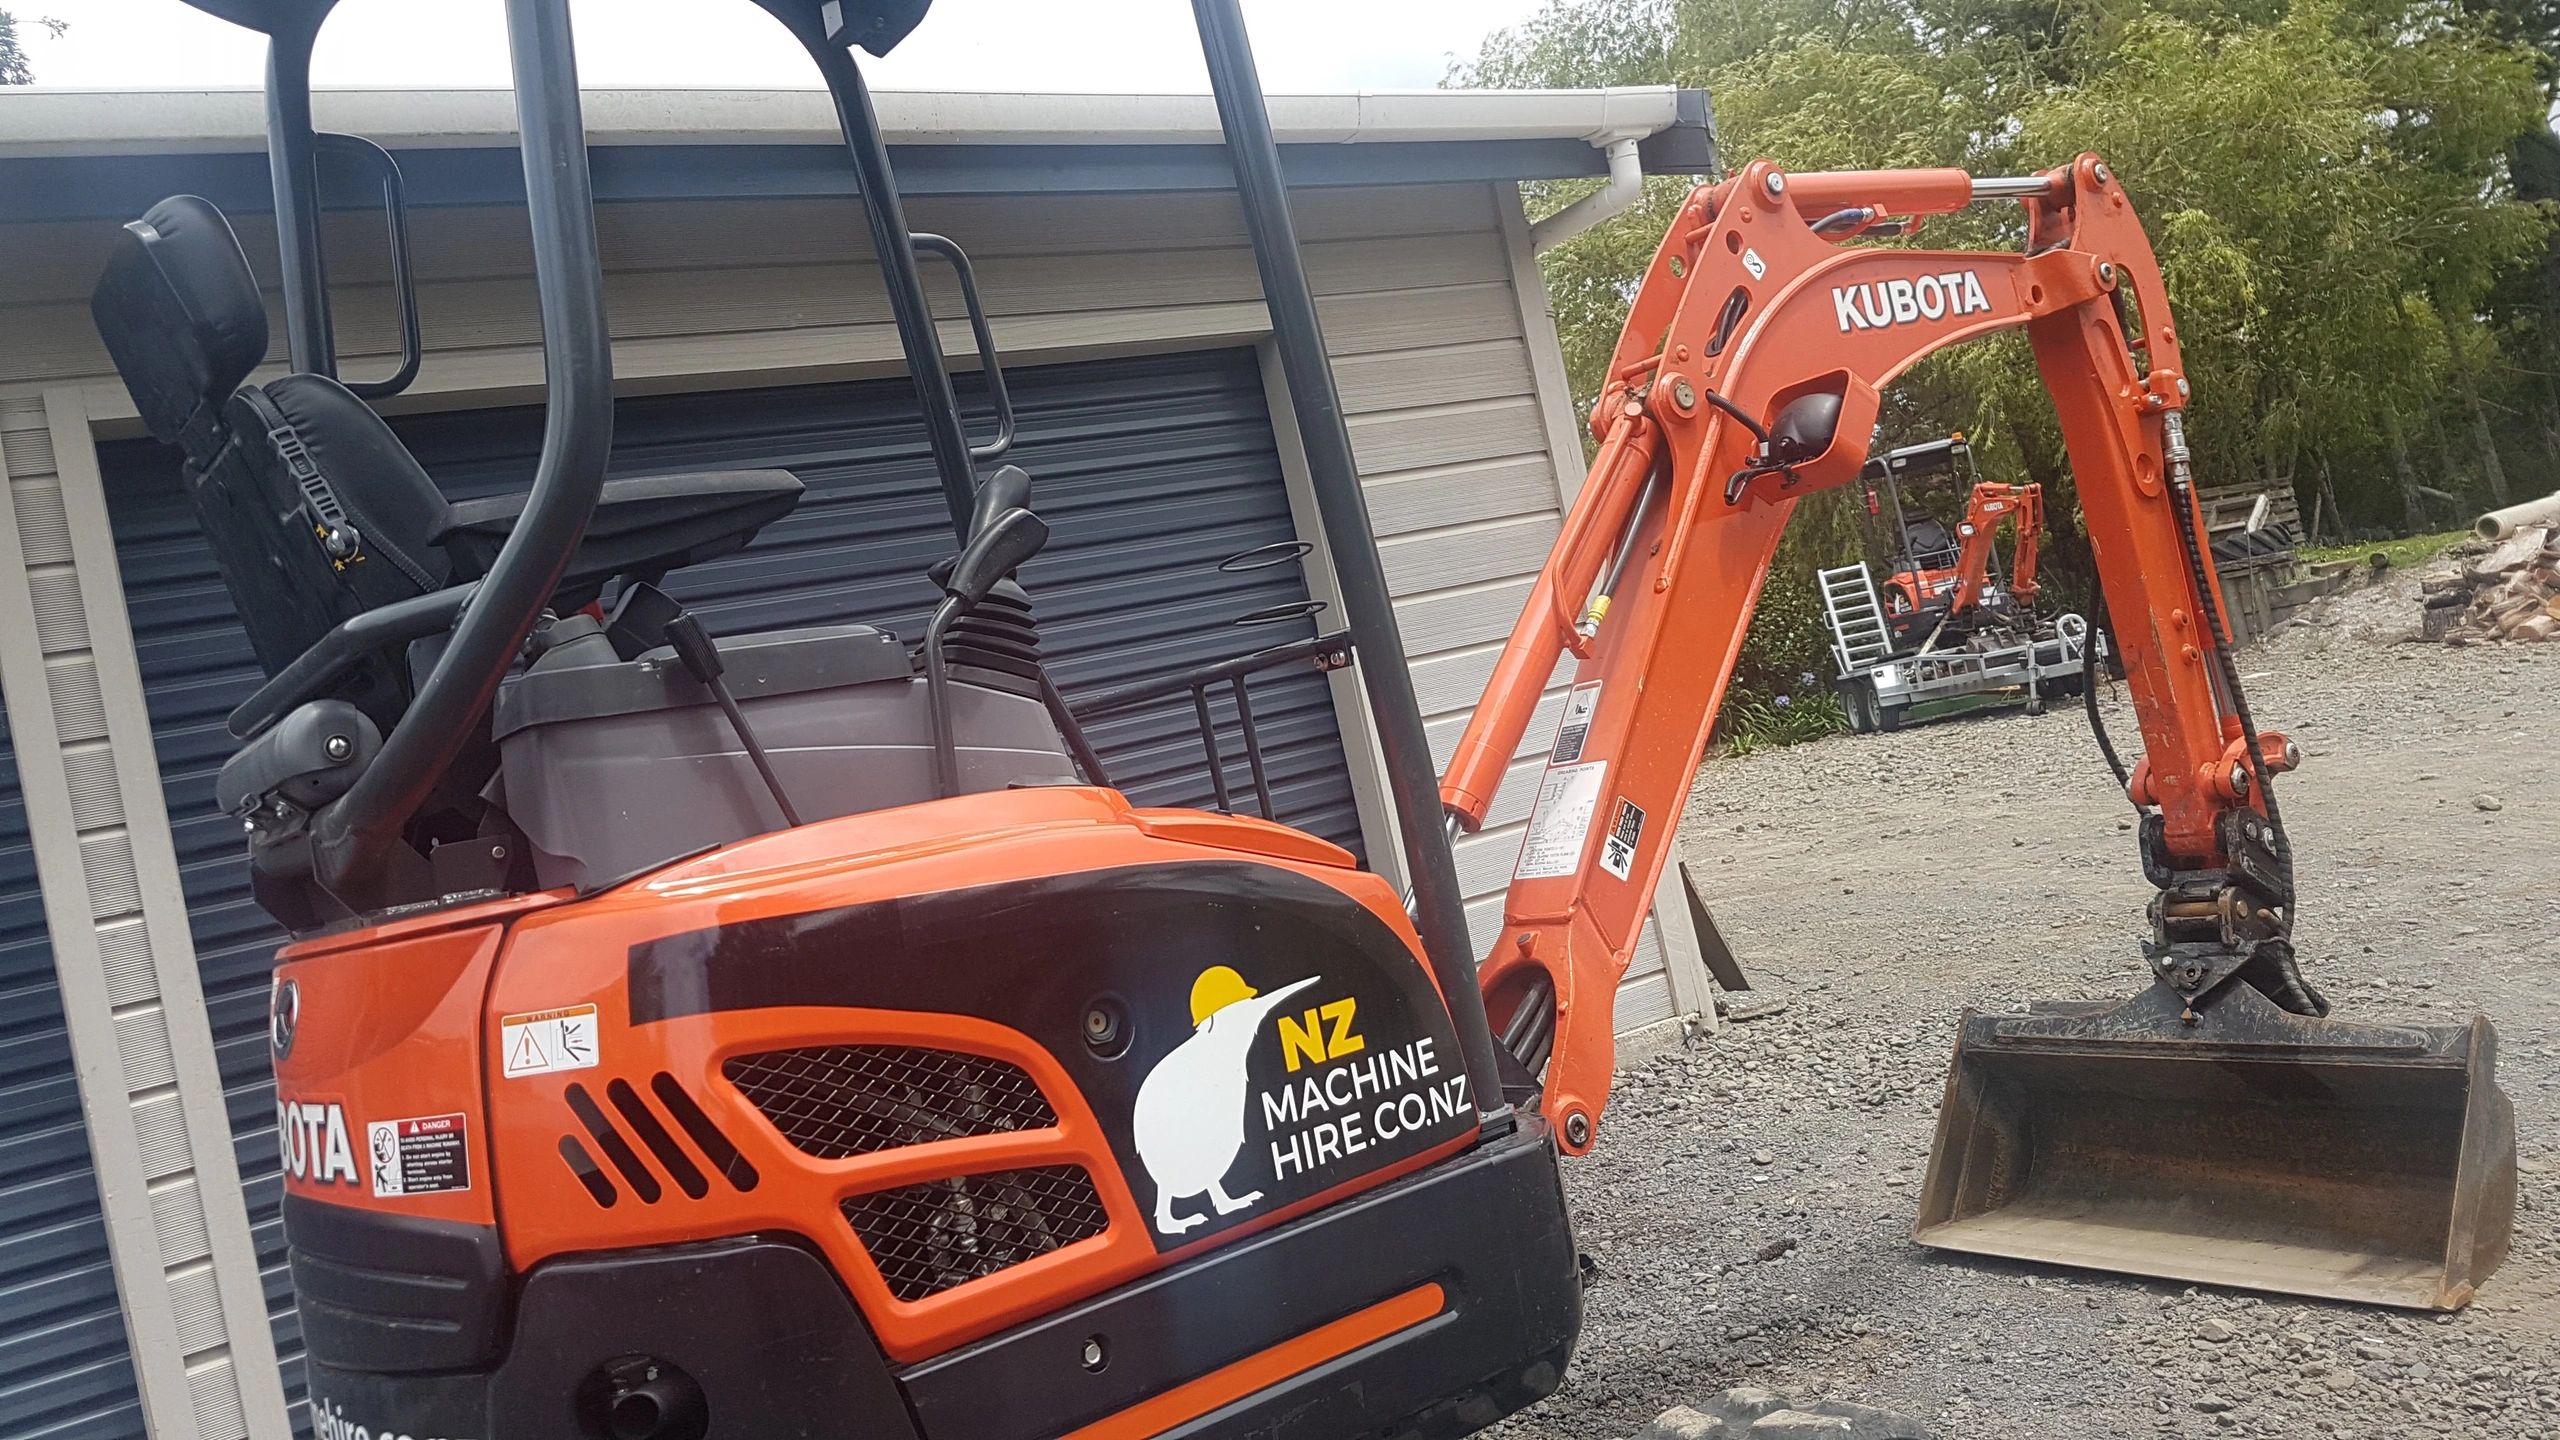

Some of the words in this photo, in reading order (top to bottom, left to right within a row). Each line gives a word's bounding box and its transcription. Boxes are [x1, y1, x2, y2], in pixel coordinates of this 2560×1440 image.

[1832, 271, 1990, 332] KUBOTA
[525, 1009, 570, 1022] WARNING
[1277, 997, 1365, 1073] NZ
[1261, 1036, 1439, 1131] MACHINE
[422, 1119, 451, 1130] DANGER
[1270, 1074, 1472, 1181] HIRE.CO.NZ
